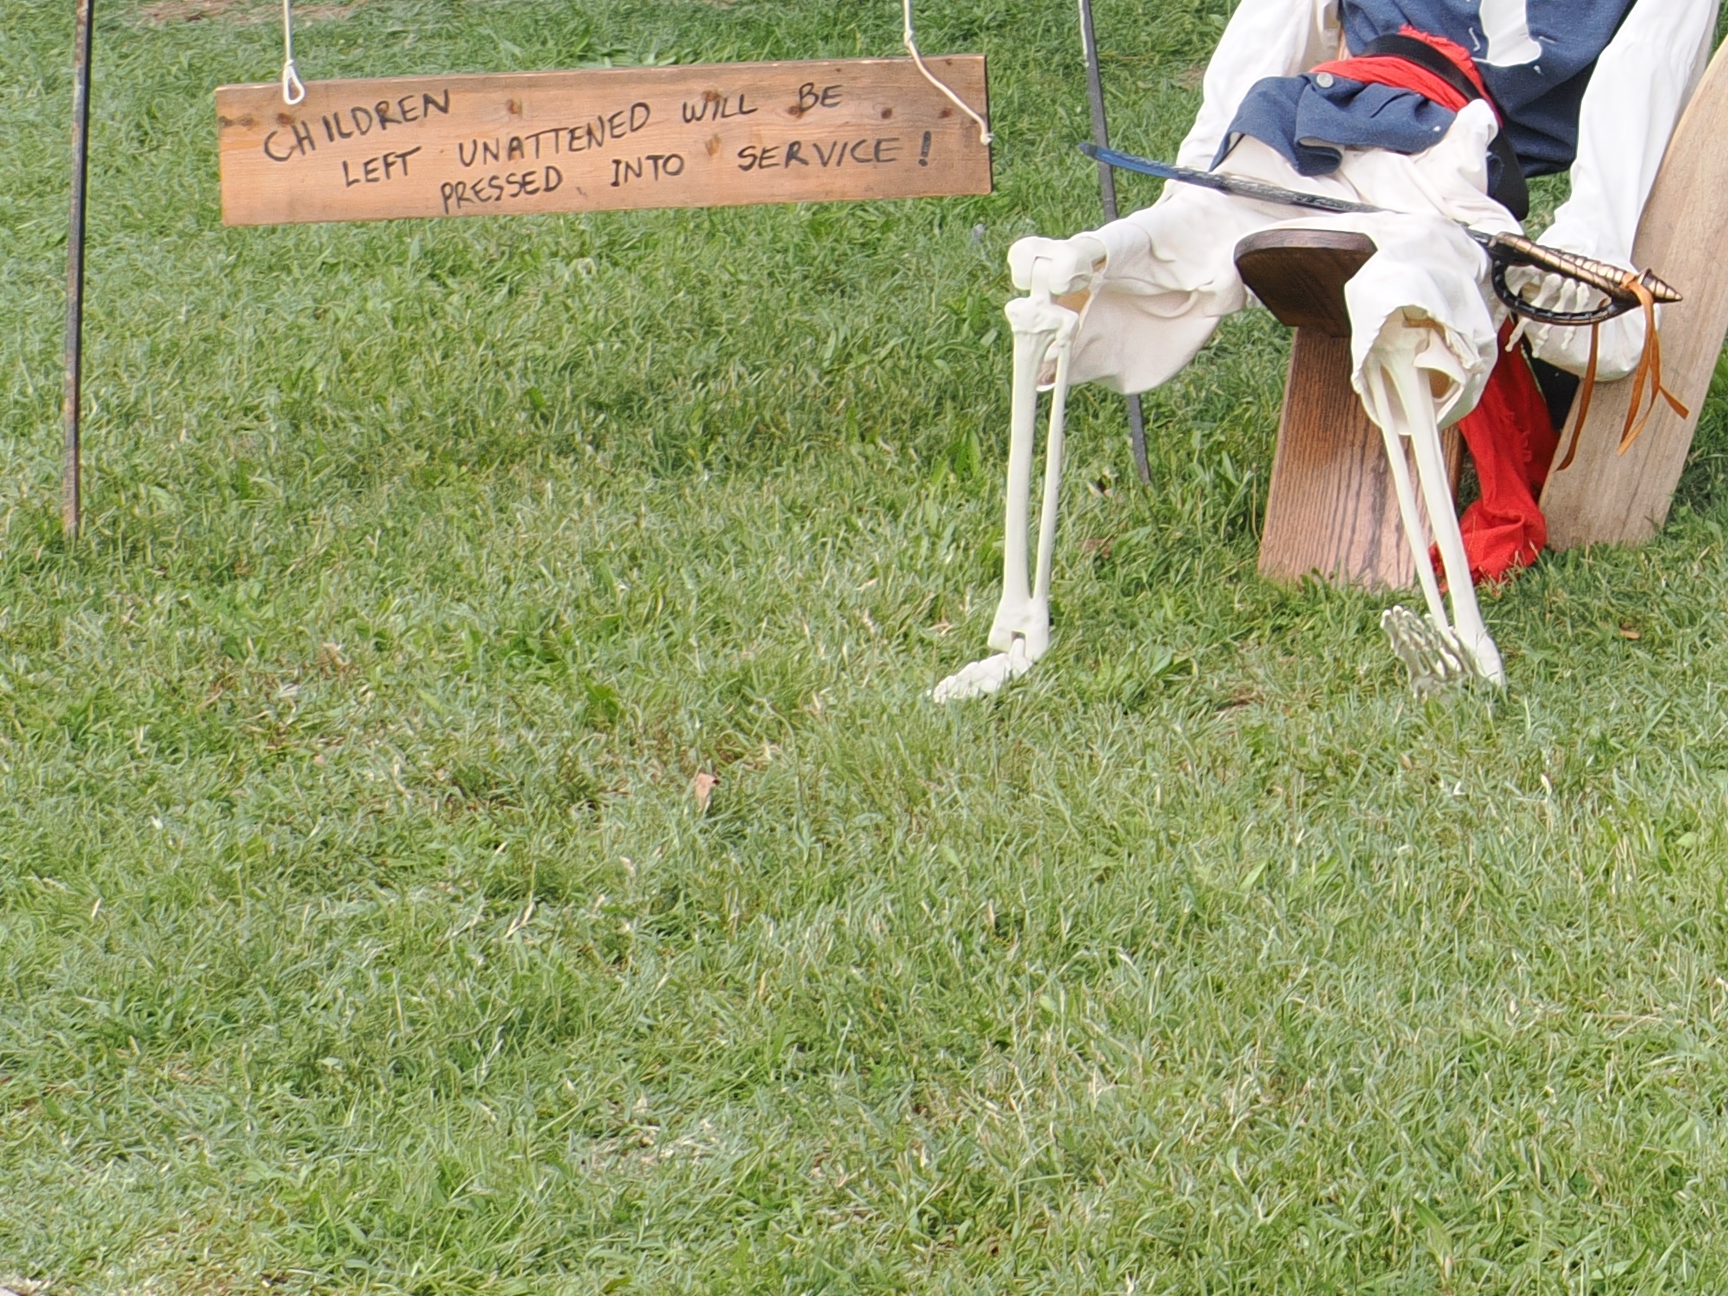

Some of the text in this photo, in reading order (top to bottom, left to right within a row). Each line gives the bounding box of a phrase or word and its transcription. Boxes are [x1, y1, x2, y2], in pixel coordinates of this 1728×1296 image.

[263, 88, 450, 163] CHILDREN
[342, 81, 842, 188] LEFT UNATTENED WILL BE
[440, 165, 563, 215] PRESSED
[609, 153, 685, 188] INTO
